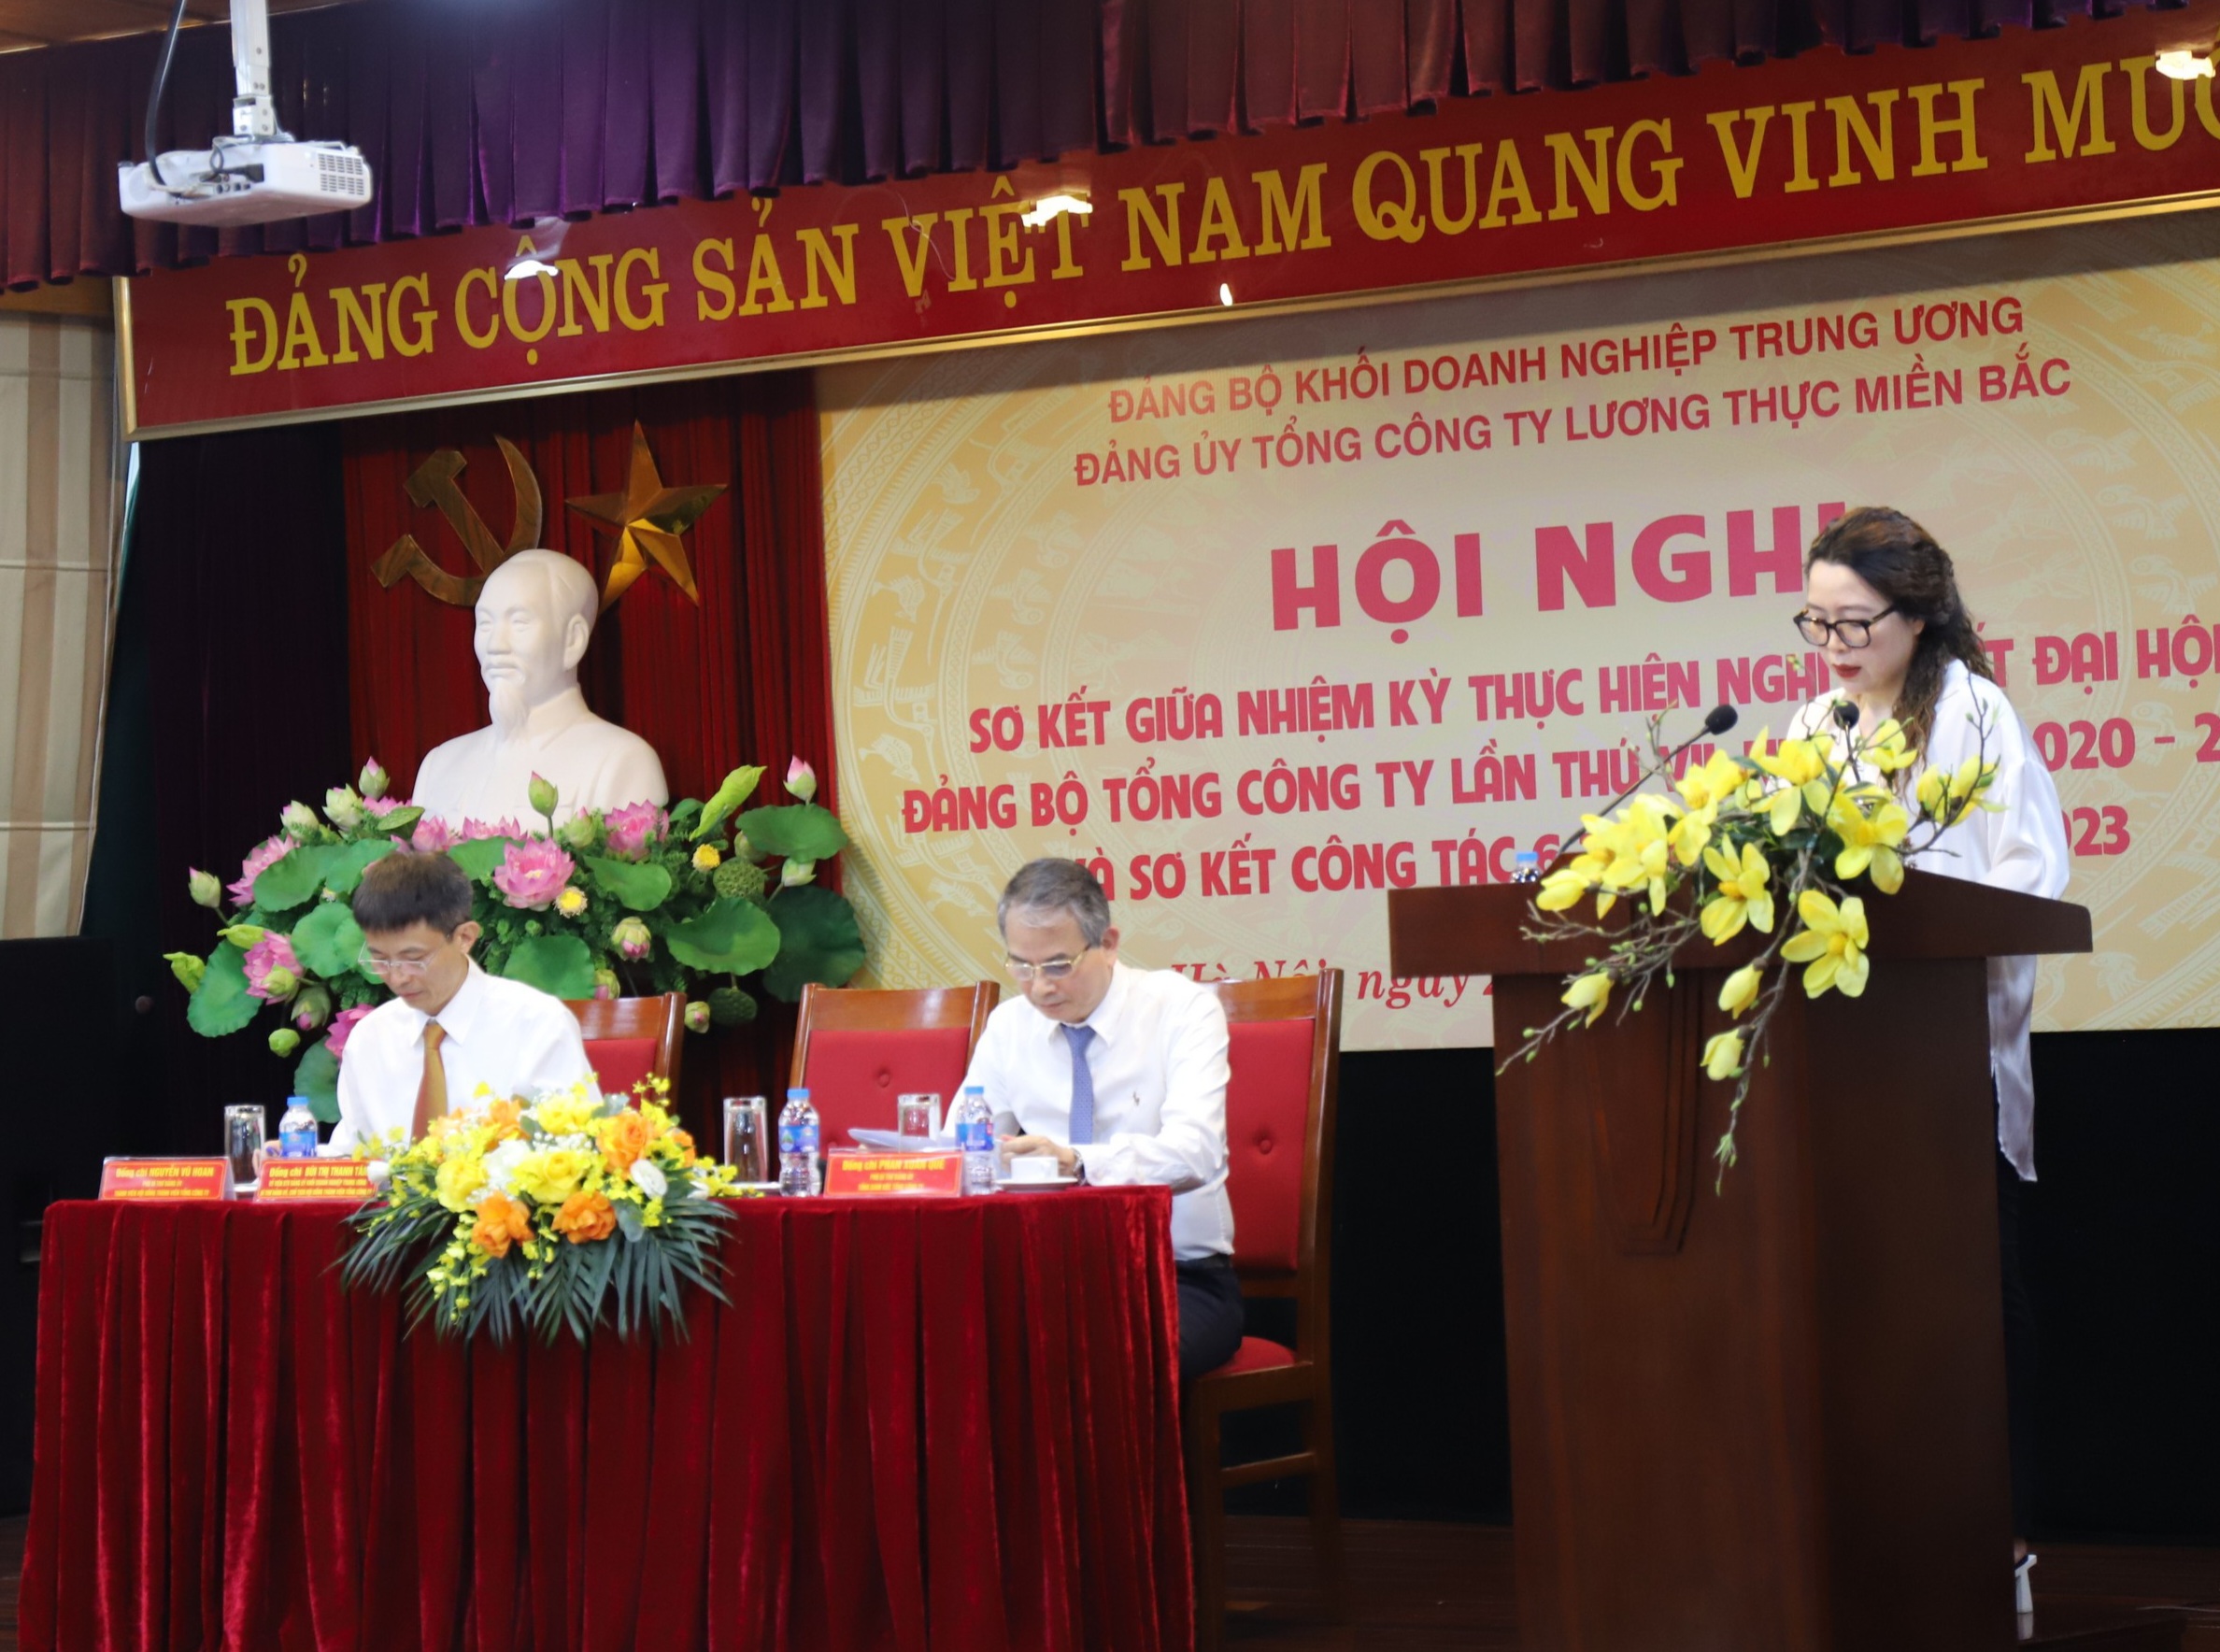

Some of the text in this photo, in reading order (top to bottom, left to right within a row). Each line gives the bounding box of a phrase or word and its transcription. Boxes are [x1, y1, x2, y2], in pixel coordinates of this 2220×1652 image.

[225, 252, 437, 376] ĐẢNG
[455, 235, 669, 364] CỘNG
[692, 197, 858, 321] SẢN
[882, 177, 1090, 308] VIỆT
[1121, 164, 1331, 272] NAM
[1352, 119, 1684, 244] QUANG
[1707, 78, 1987, 199] VINH
[1074, 342, 2071, 486] ĐẢNG ỦY TỔNG CÔNG TY LƯƠNG THỰC MIỀN BẮC
[1108, 296, 2023, 423] ĐẢNG BỘ KHỐI DOANH NGHIỆP TRUNG ƯƠNG
[1271, 519, 1483, 644] HỘI
[969, 705, 1024, 753] SƠ
[1038, 685, 1111, 749] KẾT
[1125, 687, 1223, 744] GIỮA
[1237, 675, 1374, 743] NHIỆM
[1388, 667, 1451, 727] KỲ
[1468, 667, 1584, 730] THỰC
[1599, 652, 1701, 723] HIỆN
[2032, 631, 2118, 695] ĐẠI
[902, 774, 1017, 833] ĐẢNG
[1031, 770, 1088, 836] BỘ
[1103, 757, 1222, 822] TỔNG
[1236, 758, 1360, 815] CÔNG
[1375, 759, 1434, 808] TY
[1451, 738, 1537, 805] LẦN
[2032, 718, 2135, 772] 020
[1130, 851, 1186, 901] SƠ
[1201, 832, 1276, 896] KẾT
[1291, 834, 1416, 892] CÔNG
